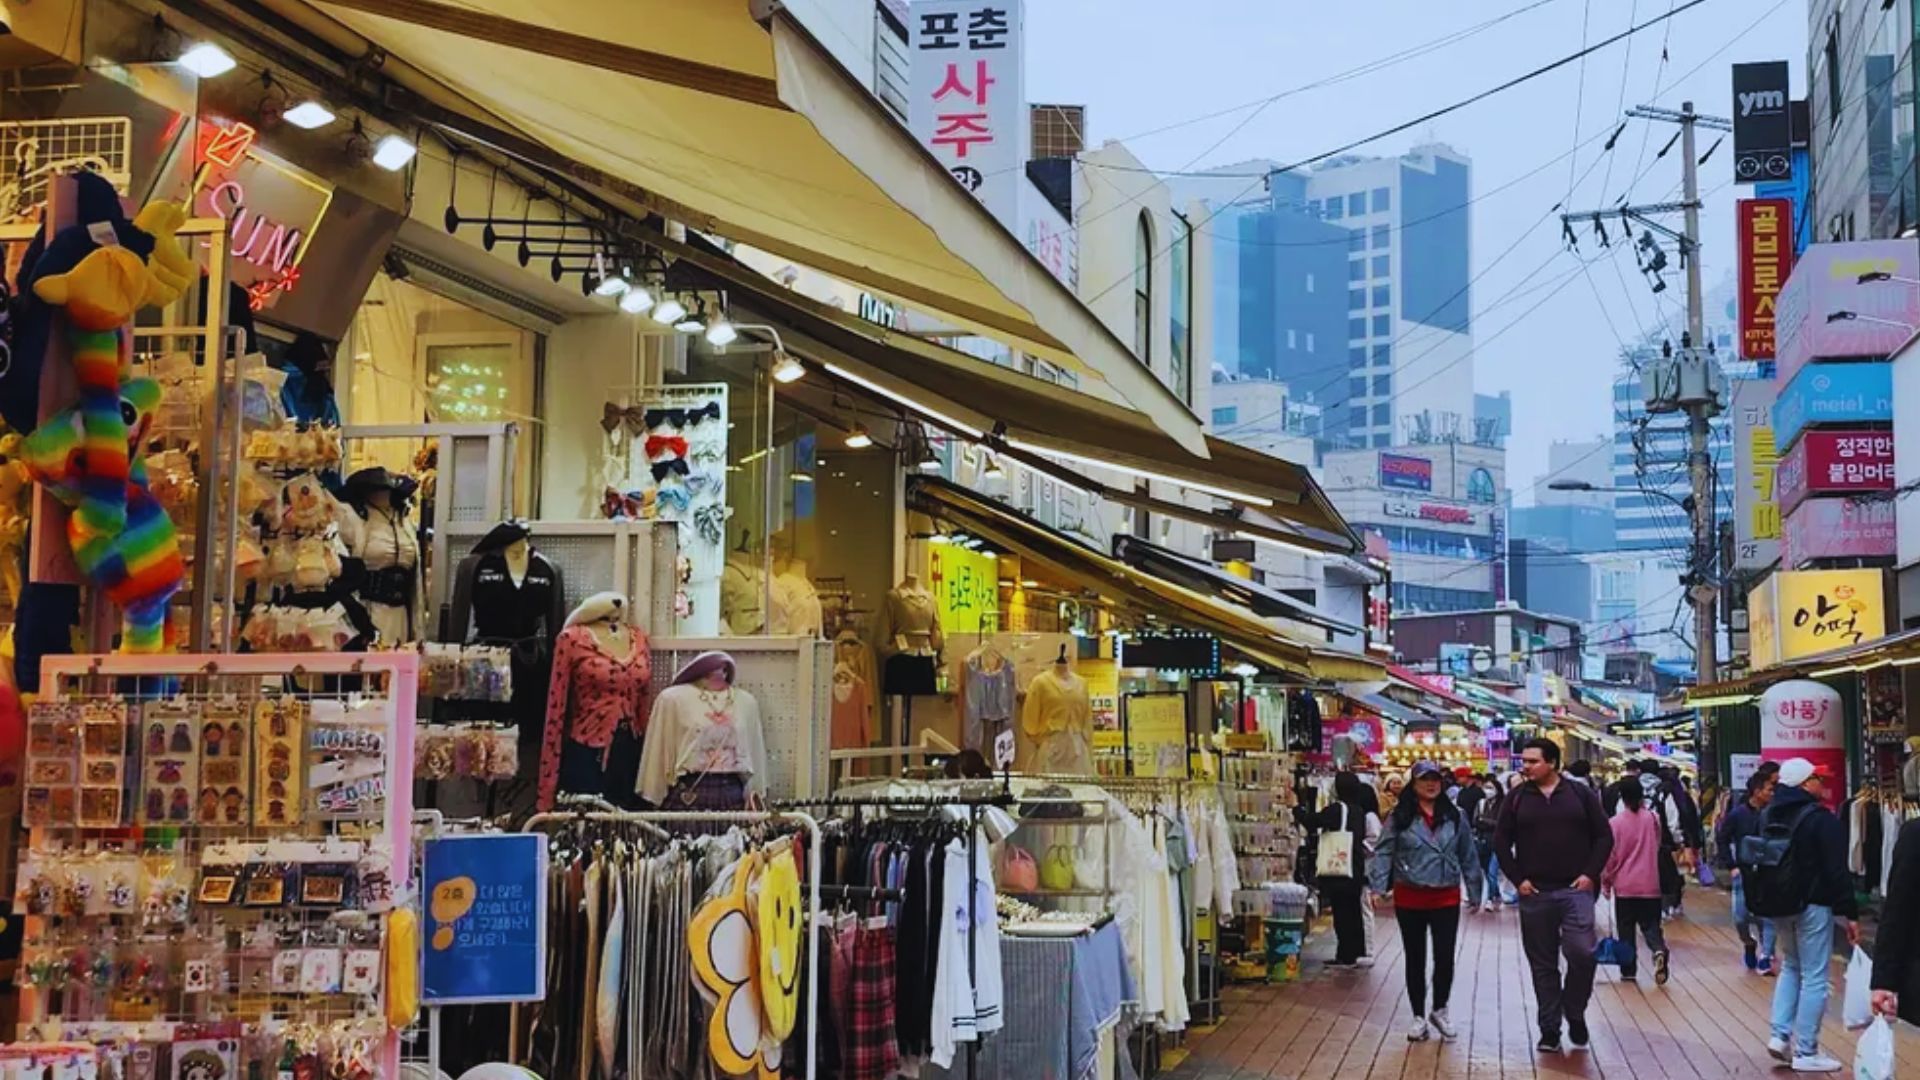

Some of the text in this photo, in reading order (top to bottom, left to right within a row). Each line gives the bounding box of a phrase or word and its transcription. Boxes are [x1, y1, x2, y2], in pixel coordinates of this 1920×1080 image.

[918, 8, 1009, 50] 포춘
[931, 60, 995, 158] 사주
[1738, 89, 1785, 118] ym
[1837, 437, 1893, 458] 정직한
[1741, 544, 1757, 559] 2F
[310, 728, 385, 753] KOREA
